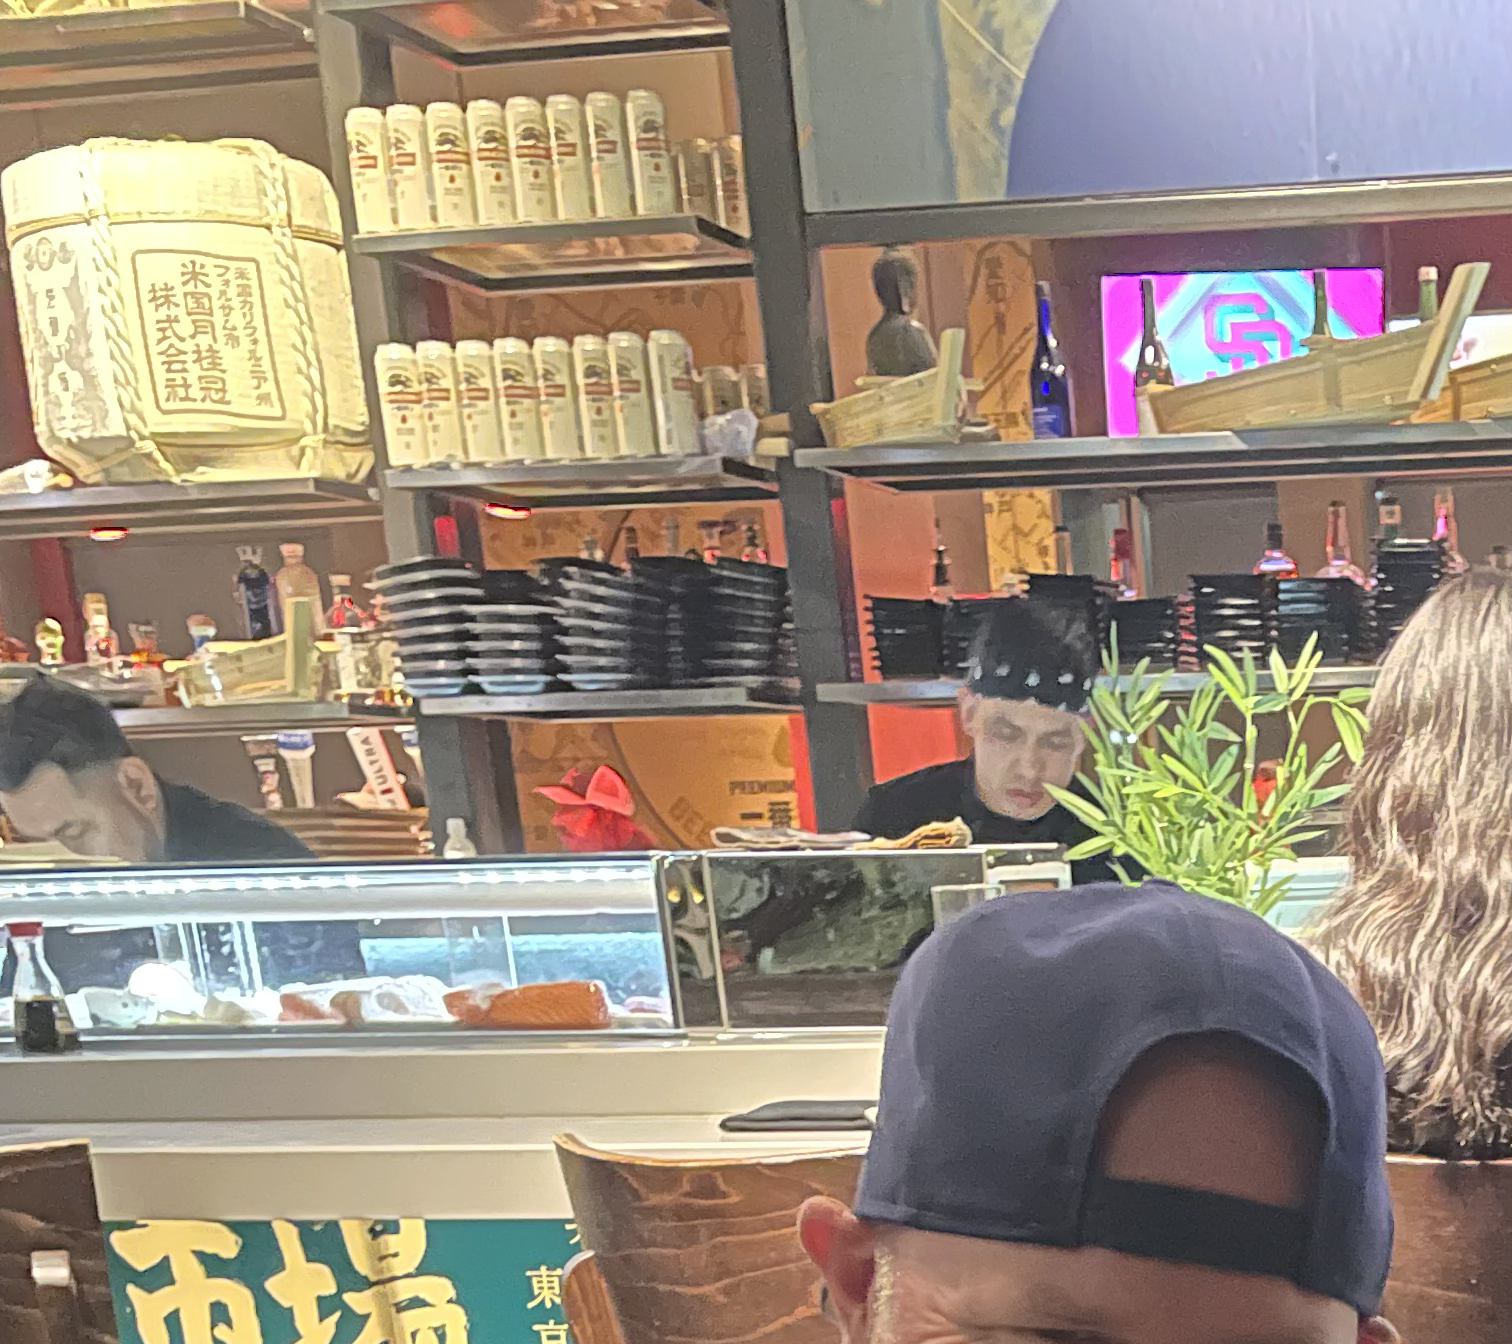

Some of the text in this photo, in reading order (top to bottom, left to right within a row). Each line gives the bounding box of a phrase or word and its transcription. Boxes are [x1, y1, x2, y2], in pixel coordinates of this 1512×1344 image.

[147, 281, 198, 404] 株式会社
[181, 259, 232, 406] 米国月桂冠
[360, 735, 389, 787] ULTRA
